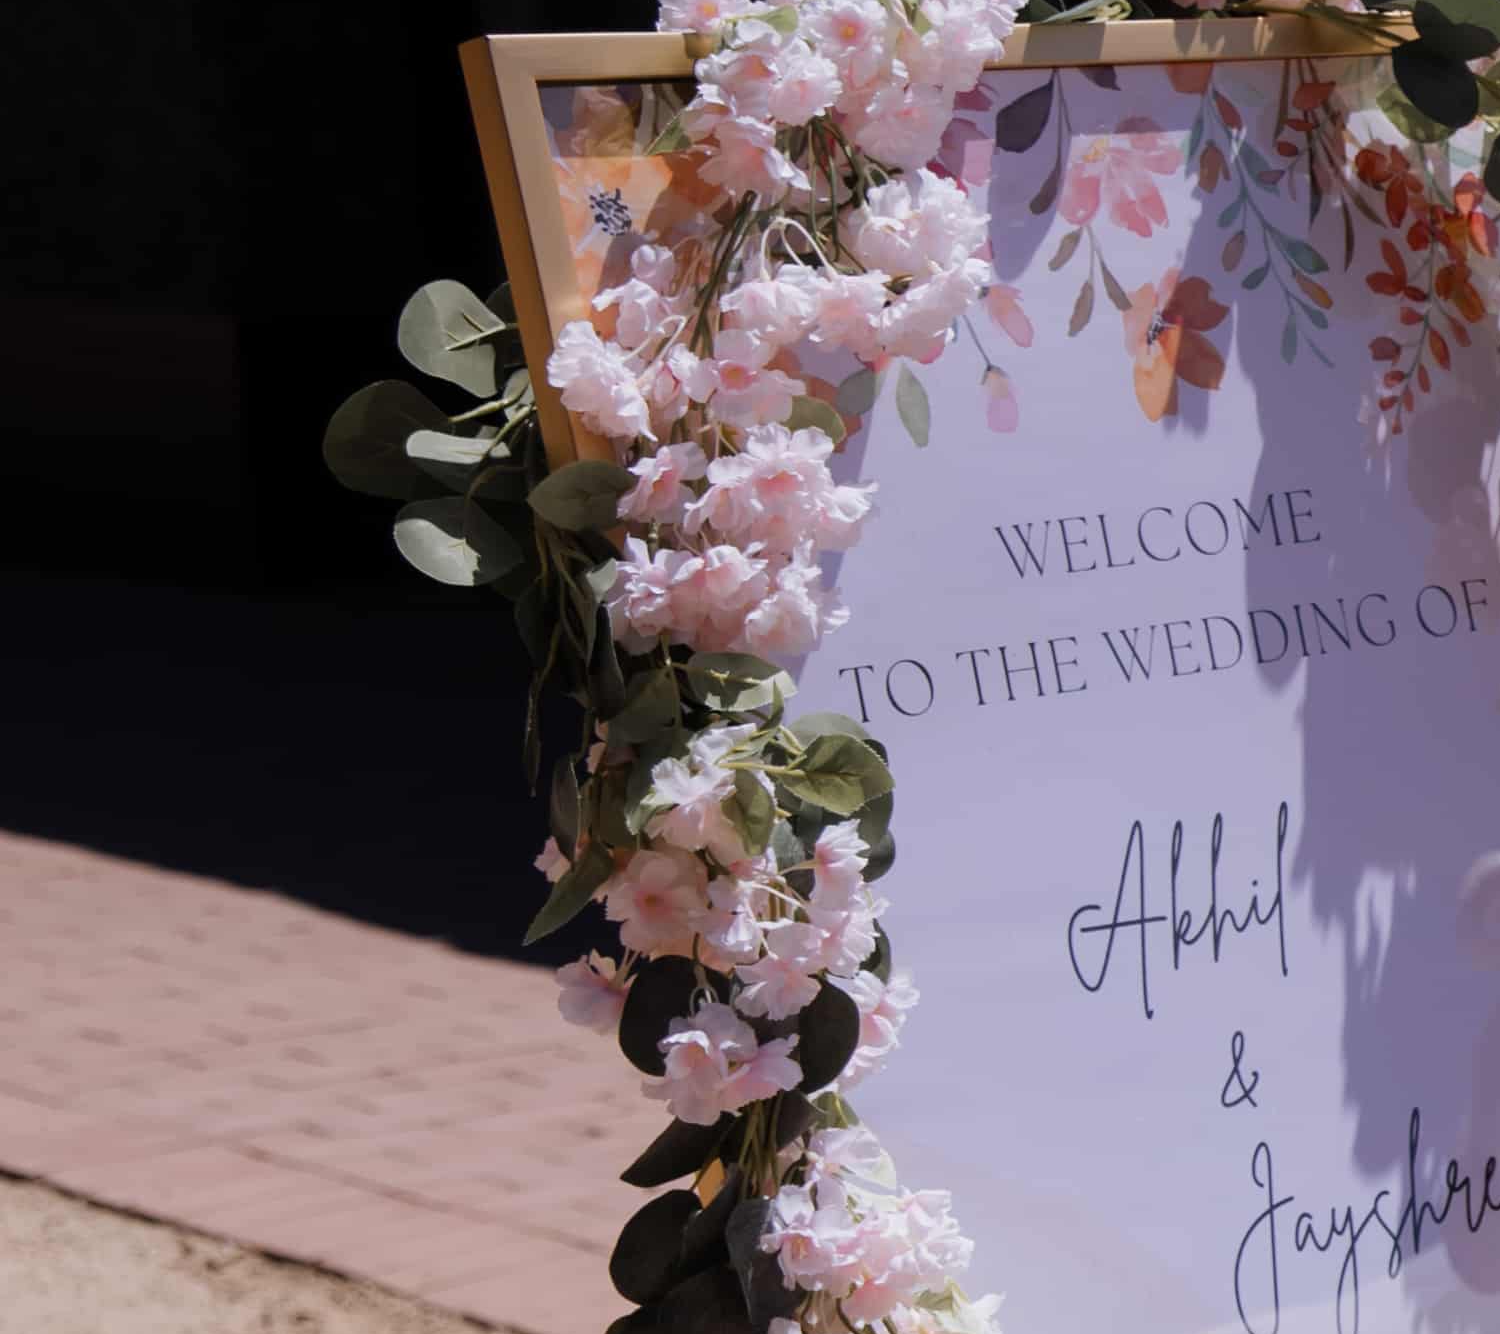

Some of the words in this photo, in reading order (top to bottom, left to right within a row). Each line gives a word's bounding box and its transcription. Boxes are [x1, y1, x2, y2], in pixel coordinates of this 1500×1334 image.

[993, 488, 1321, 578] WELCOME
[839, 656, 935, 724] TO
[955, 636, 1087, 707] THE
[1101, 593, 1397, 684] WEDDING
[1417, 578, 1490, 638] OF
[1069, 801, 1290, 1019] Akhil
[1220, 1030, 1260, 1109] &
